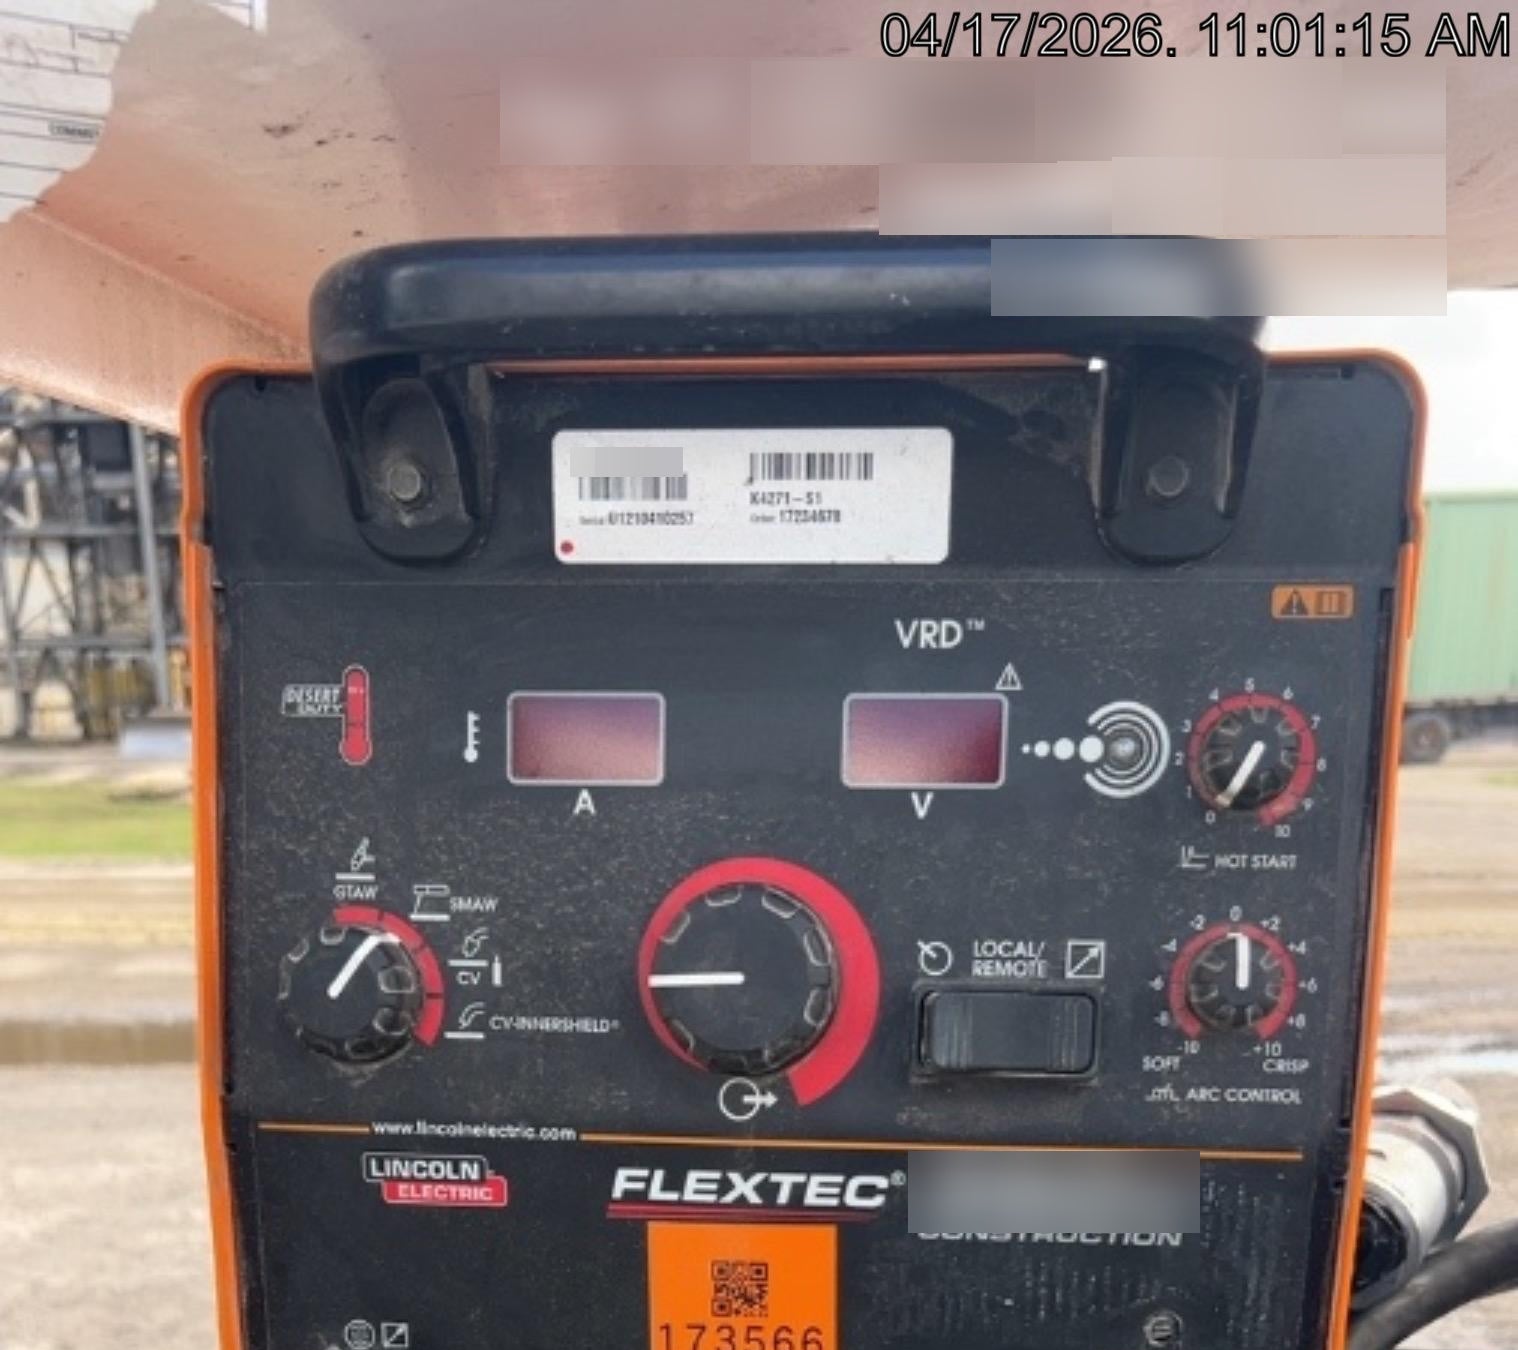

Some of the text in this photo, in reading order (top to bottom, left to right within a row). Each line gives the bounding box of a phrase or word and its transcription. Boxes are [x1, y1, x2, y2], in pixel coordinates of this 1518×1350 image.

[287, 686, 341, 702] DESERT
[572, 789, 597, 815] A
[911, 791, 934, 820] V
[1214, 855, 1297, 870] HOT START
[333, 884, 379, 900] GTAW
[449, 896, 499, 913] SMAW
[971, 959, 1049, 978] REMOTE
[457, 971, 481, 985] CV
[1142, 1056, 1181, 1072] SOFT
[1262, 1058, 1310, 1074] CRISP
[1187, 1088, 1301, 1104] ARC CONTROL
[371, 1119, 577, 1141] www.lincolnelectric.com
[370, 1157, 480, 1181] LINCOLN
[397, 1183, 493, 1202] ELECTRIC
